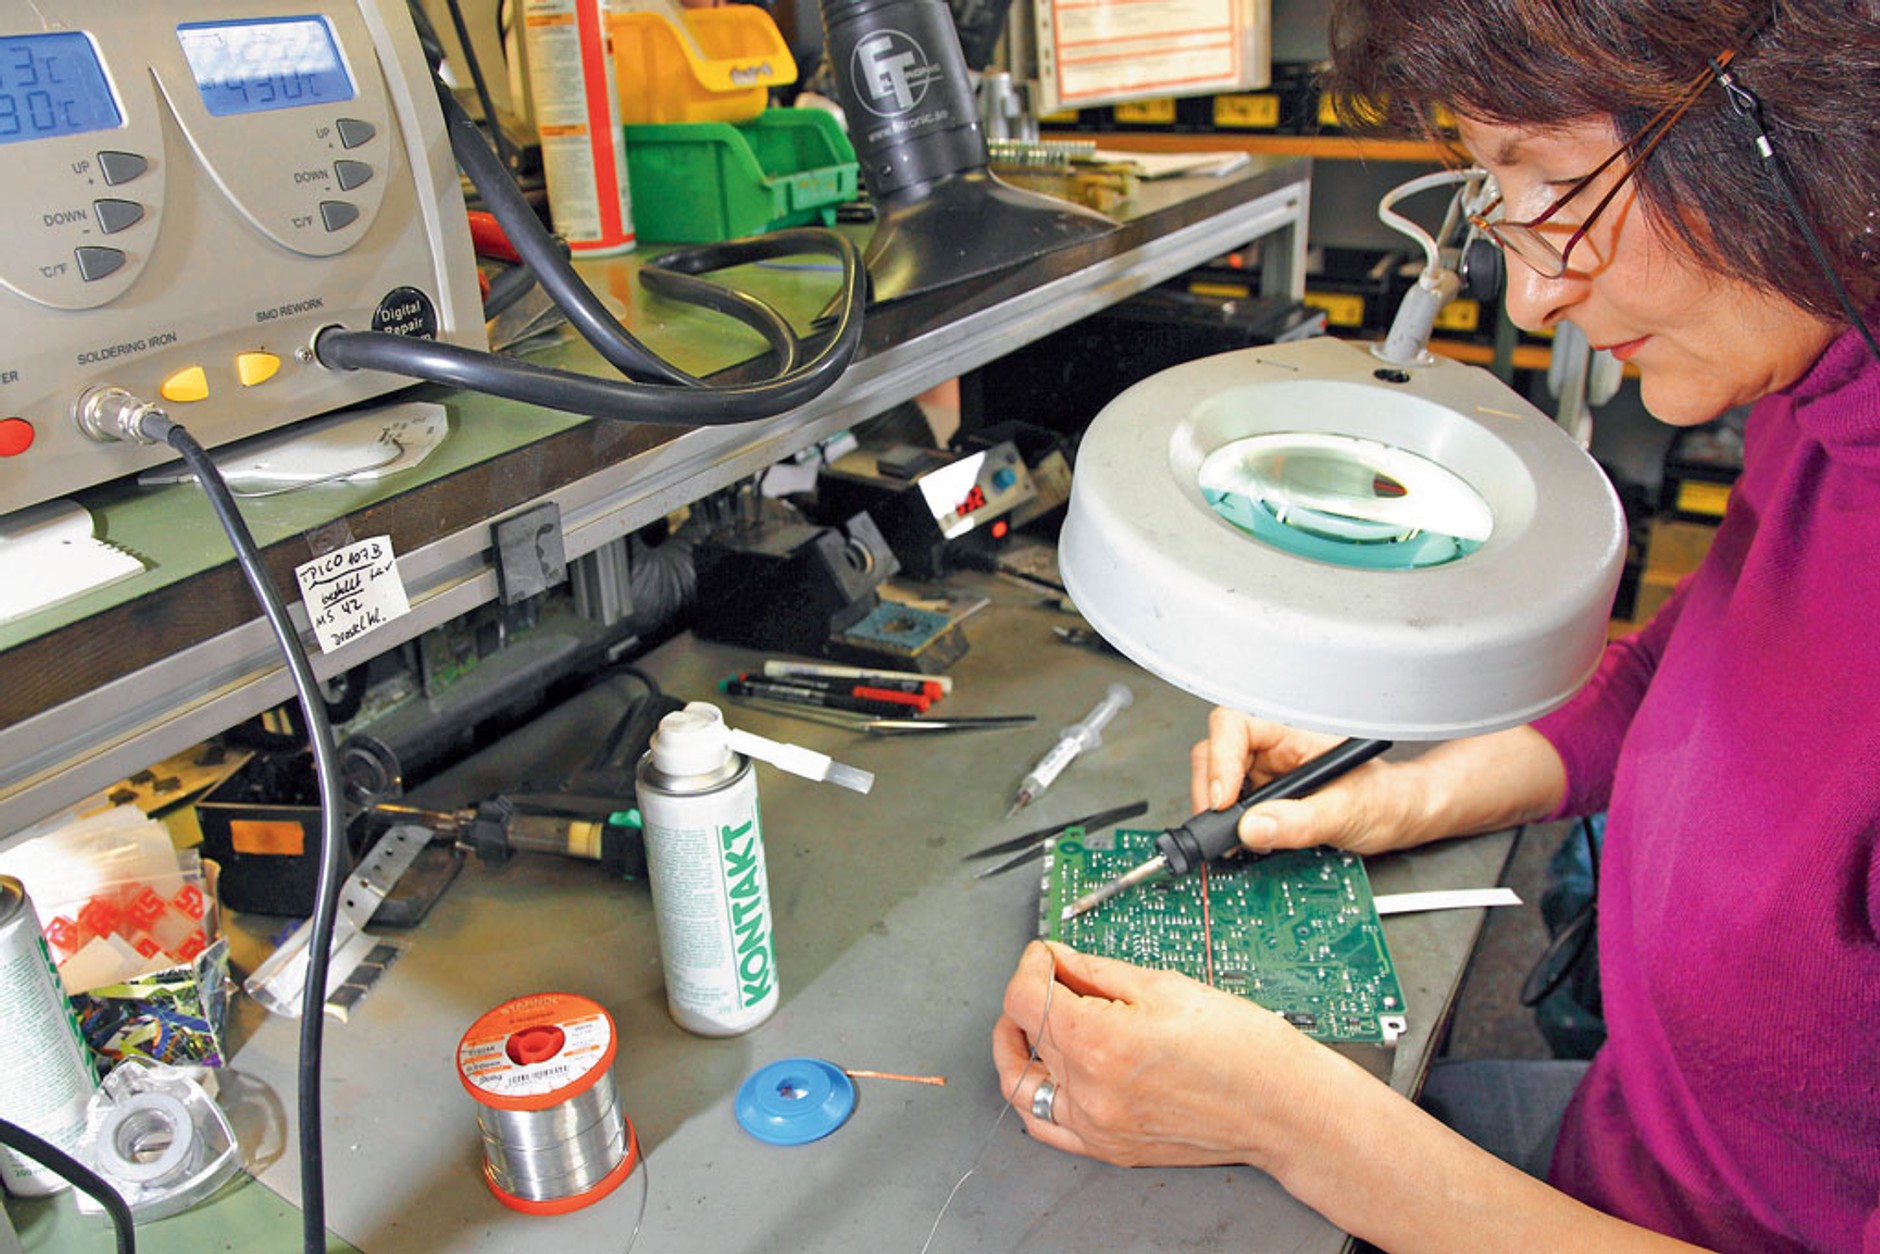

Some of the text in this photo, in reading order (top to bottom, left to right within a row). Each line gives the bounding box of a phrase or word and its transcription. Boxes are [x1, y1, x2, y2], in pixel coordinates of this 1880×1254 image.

[315, 127, 330, 139] UP
[71, 161, 89, 174] UP
[293, 169, 329, 183] DOWN
[43, 209, 87, 227] DOWN
[256, 298, 324, 323] SMD REWORK
[381, 300, 422, 322] Digital
[384, 317, 424, 336] Repair
[77, 332, 177, 365] SOLDERING IRON
[341, 598, 363, 614] 42
[721, 819, 772, 1008] KONTAKT
